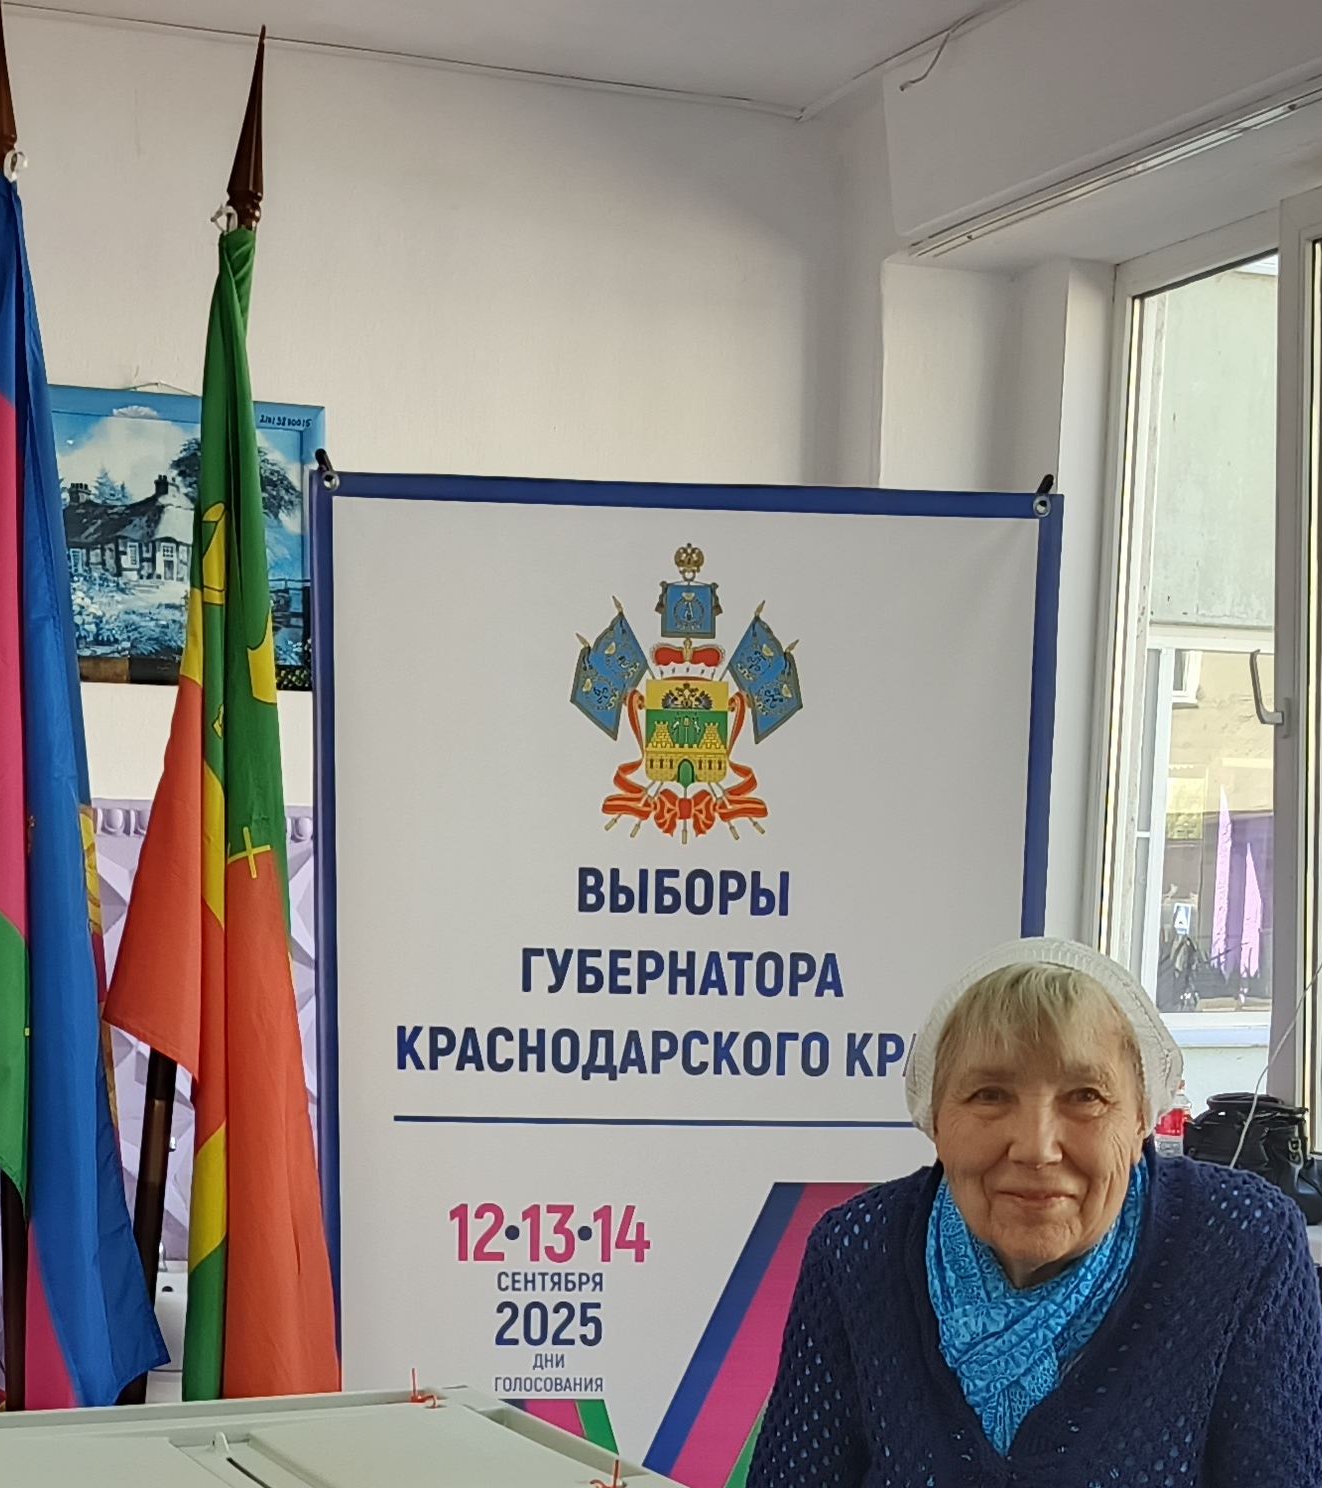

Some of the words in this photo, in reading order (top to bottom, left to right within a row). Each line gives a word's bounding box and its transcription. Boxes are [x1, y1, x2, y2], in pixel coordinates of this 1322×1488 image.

[577, 867, 790, 916] ВЫБОРЫ
[520, 947, 844, 998] ГУБЕРНАТОРА
[396, 1025, 830, 1081] КРАСНОДАРСКОГО
[845, 1033, 917, 1077] КР
[497, 1271, 604, 1293] СЕНТЯБРЯ
[495, 1301, 603, 1347] 2025
[494, 1377, 604, 1392] ГОЛОСОВАНИЯ
[532, 1353, 565, 1371] ДНИ
